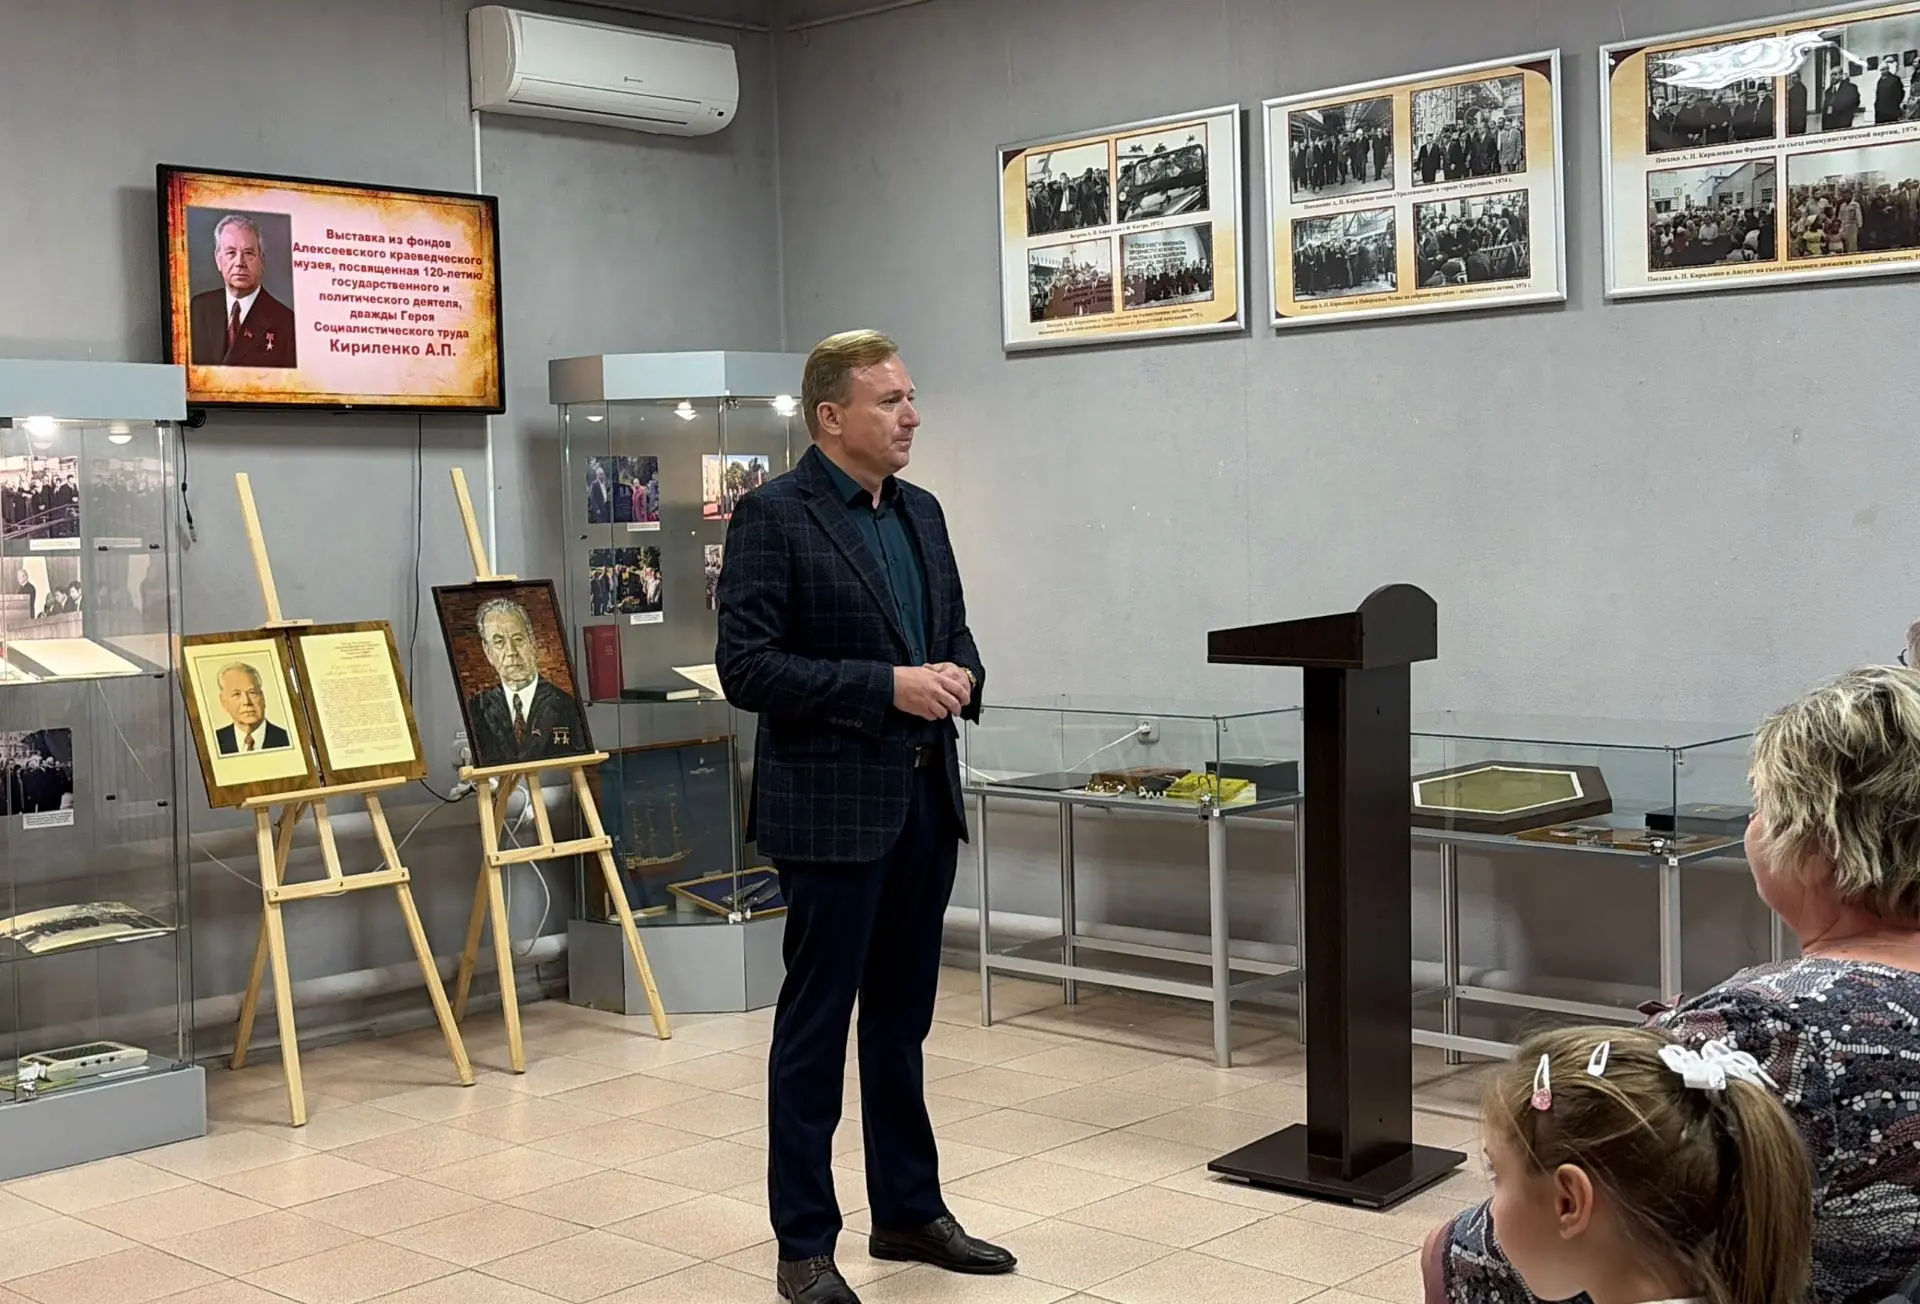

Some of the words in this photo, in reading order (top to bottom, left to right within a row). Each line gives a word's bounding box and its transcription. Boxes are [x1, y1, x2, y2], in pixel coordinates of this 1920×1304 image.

[326, 229, 385, 244] Выставка
[389, 236, 402, 244] из
[406, 236, 452, 250] фондов
[293, 242, 386, 259] Алексеевского
[390, 252, 482, 266] краеведческого
[294, 260, 335, 272] музея,
[339, 262, 420, 277] посвященная
[423, 267, 483, 280] 120-летию
[332, 277, 439, 292] государственного
[319, 292, 410, 306] политического
[413, 298, 462, 310] деятеля,
[350, 310, 398, 320] дважды
[400, 311, 434, 323] Героя
[314, 322, 434, 337] Социалистического
[437, 329, 469, 340] труда
[330, 339, 420, 356] Кириленко
[425, 344, 456, 356] А.П.
